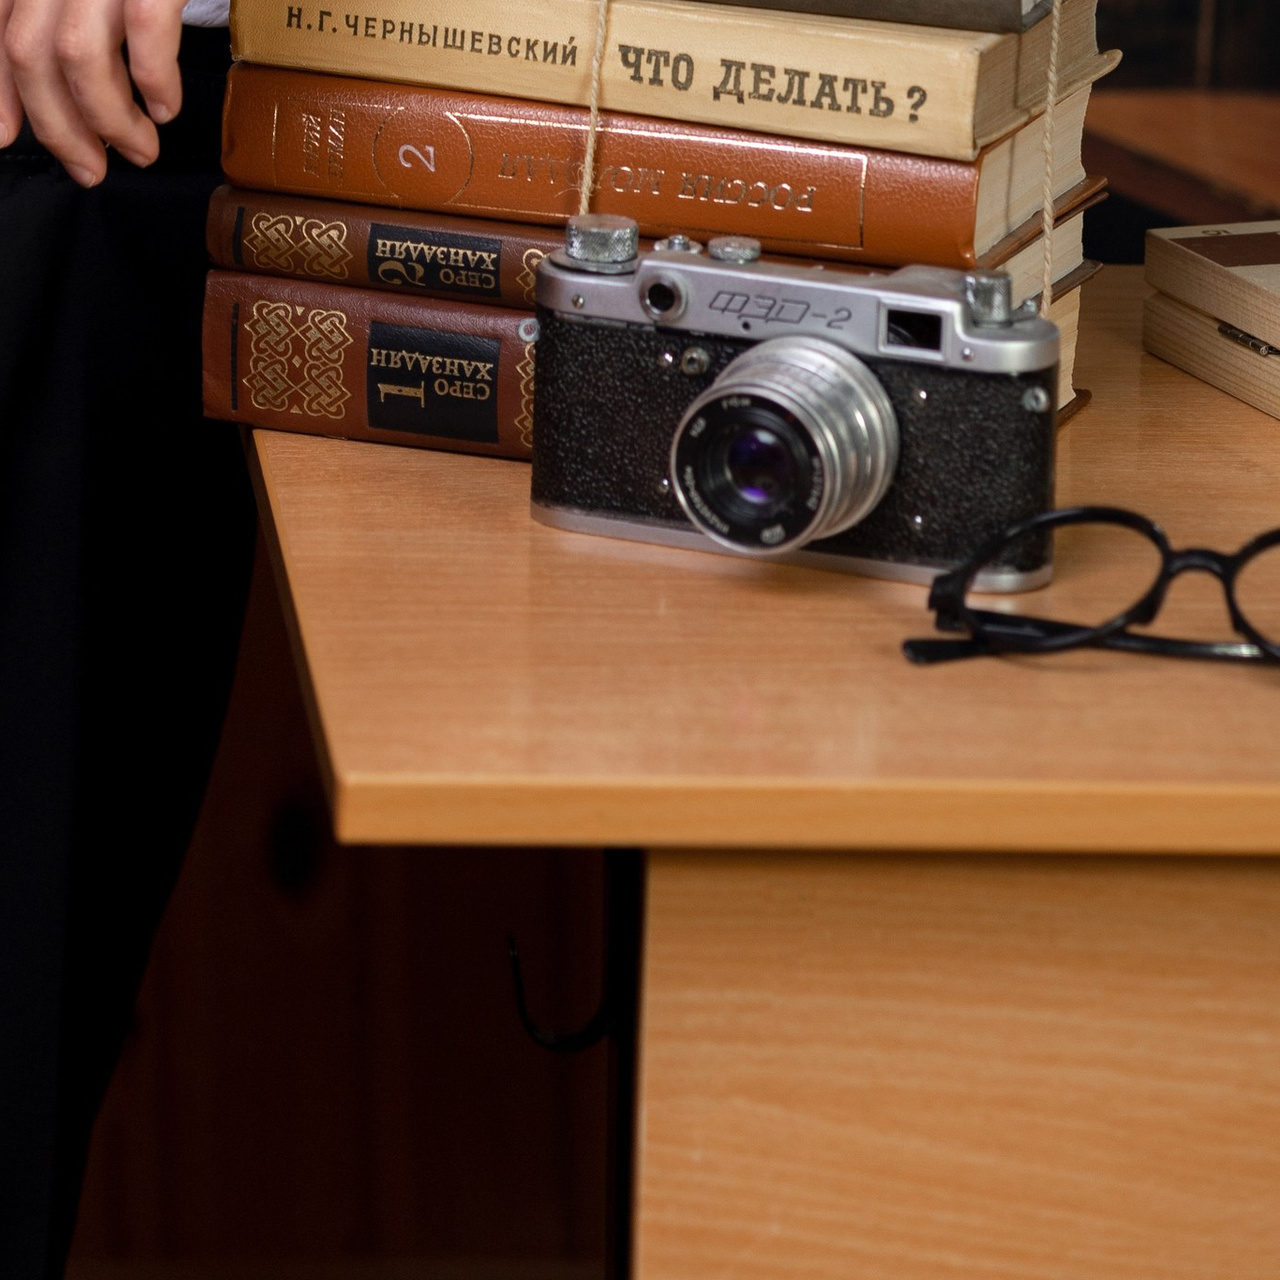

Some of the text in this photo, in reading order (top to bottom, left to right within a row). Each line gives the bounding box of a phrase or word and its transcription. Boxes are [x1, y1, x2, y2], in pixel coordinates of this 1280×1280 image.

[618, 44, 694, 90] ЧТО
[398, 143, 436, 172] 2
[677, 171, 817, 213] РОССИЯ
[375, 238, 498, 271] ХАНЗАДЯН
[378, 259, 426, 287] 2
[439, 268, 496, 289] СЕРО
[370, 347, 494, 381] ХАНЗАДЯН
[377, 380, 425, 408] 1
[434, 378, 491, 400] СЕРО
